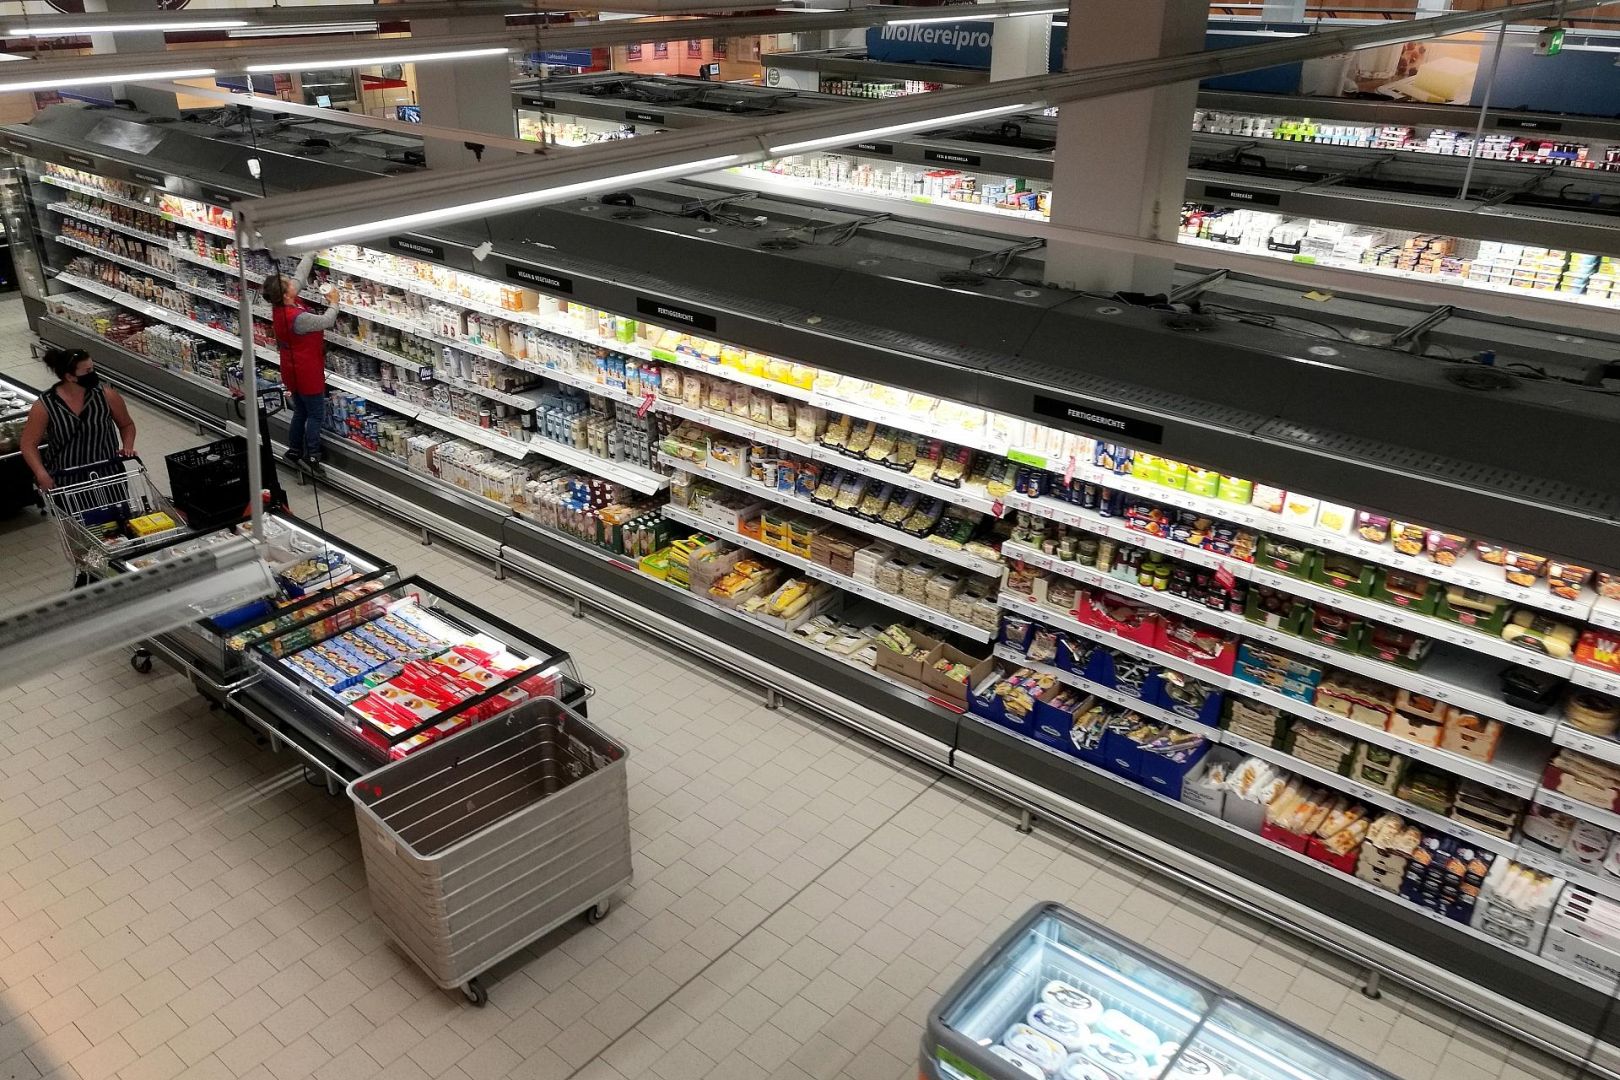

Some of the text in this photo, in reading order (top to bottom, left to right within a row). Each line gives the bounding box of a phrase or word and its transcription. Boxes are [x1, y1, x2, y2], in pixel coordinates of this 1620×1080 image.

[881, 24, 993, 50] Molkereipro
[413, 243, 434, 254] VEGETARISCH
[518, 271, 531, 279] VEGAN
[535, 275, 560, 286] VEGETARISCH
[657, 307, 694, 322] FERTIGGERICHTE
[1068, 409, 1126, 429] FERTIGGERICHTE
